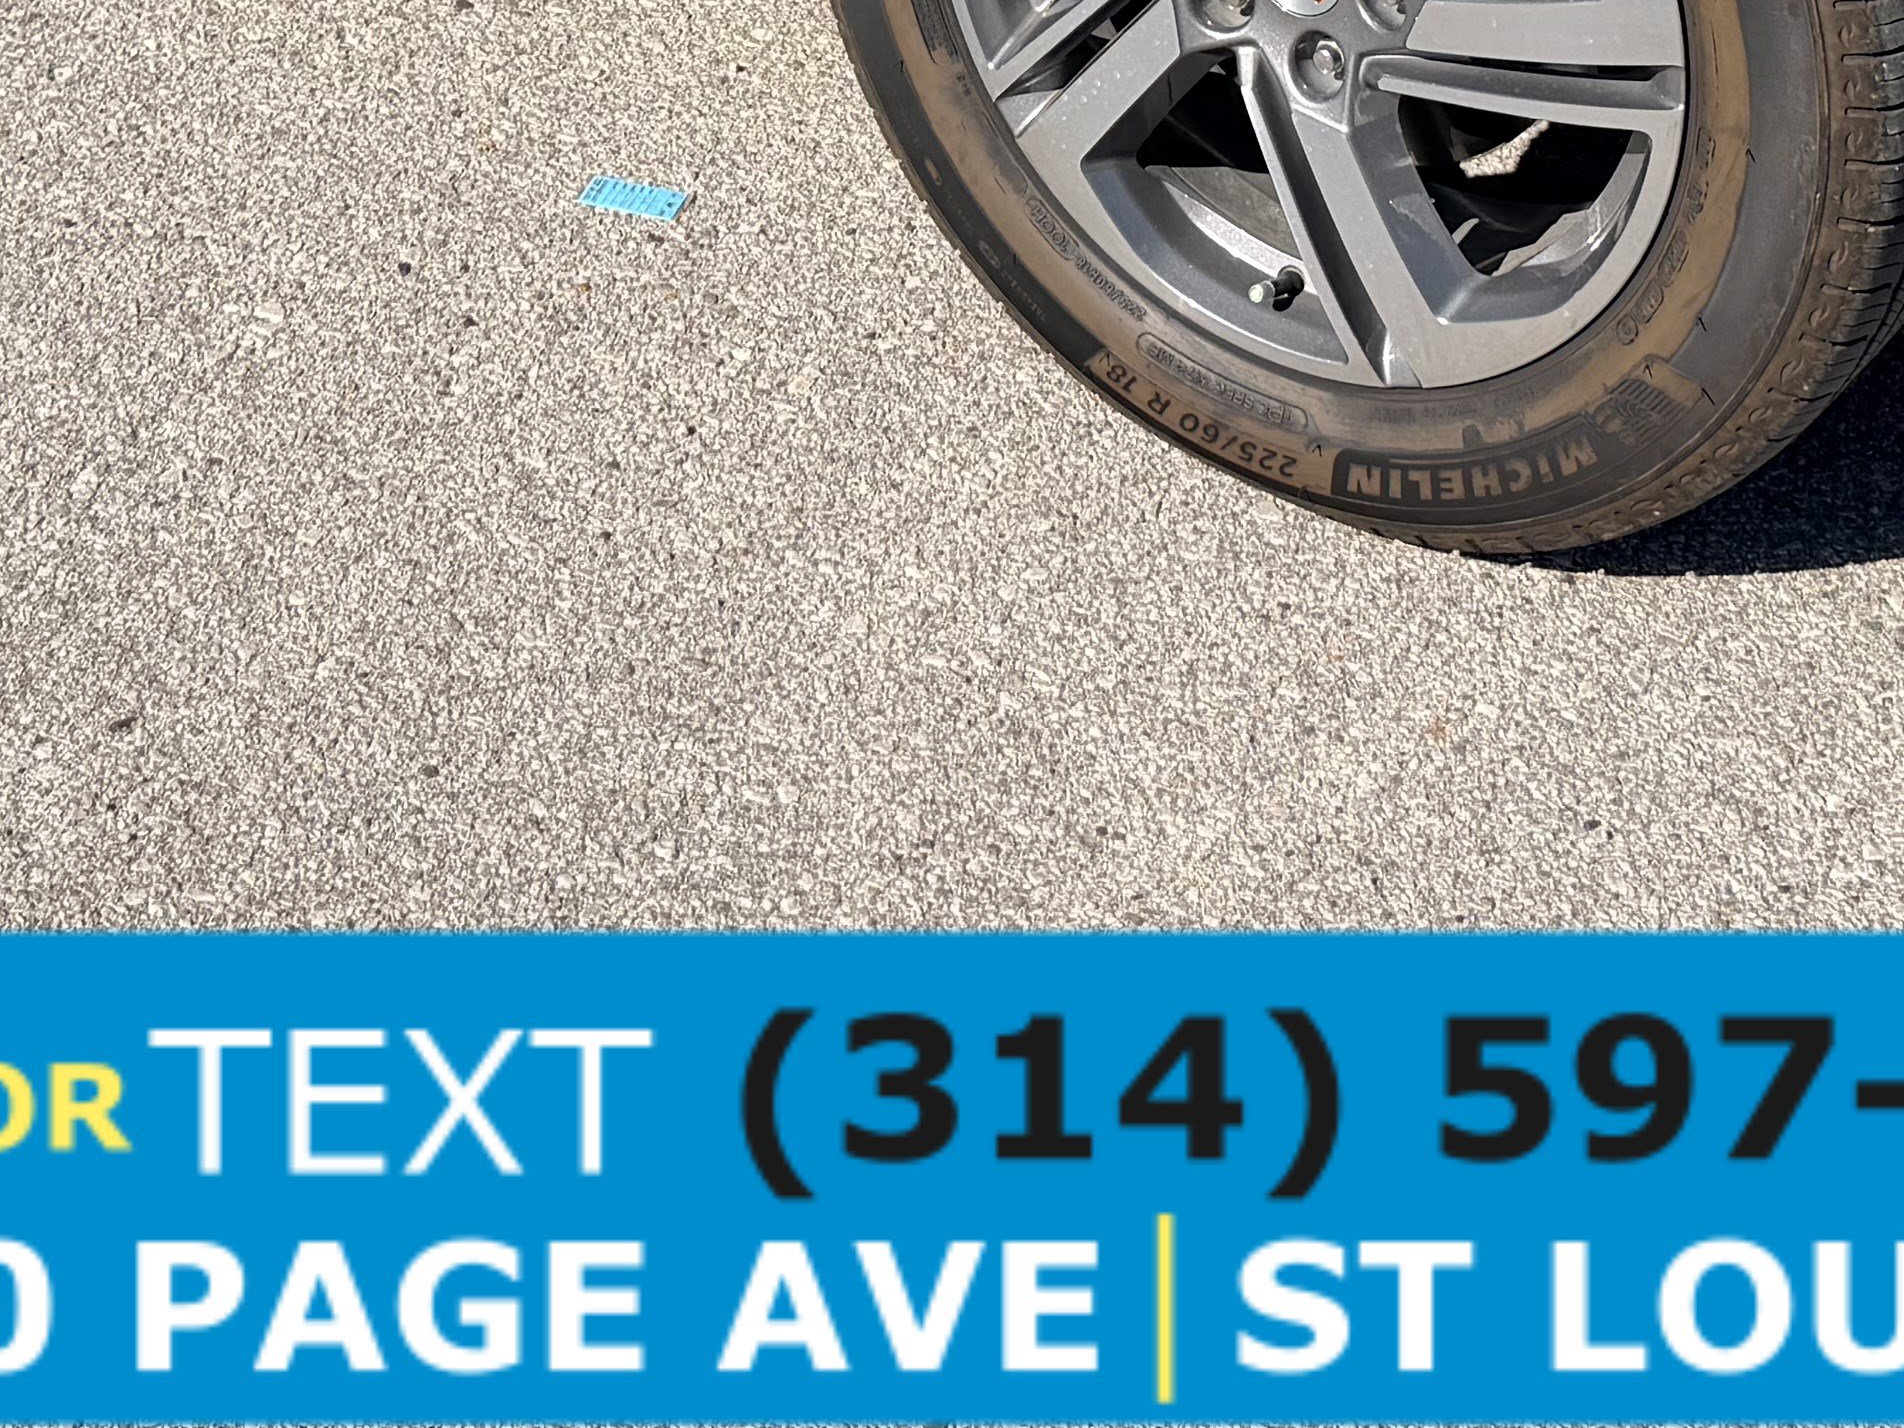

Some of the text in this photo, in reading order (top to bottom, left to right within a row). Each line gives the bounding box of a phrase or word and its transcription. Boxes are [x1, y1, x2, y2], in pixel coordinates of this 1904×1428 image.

[1105, 365, 1298, 478] 225/60 R 18
[1346, 433, 1598, 501] MICHELIN
